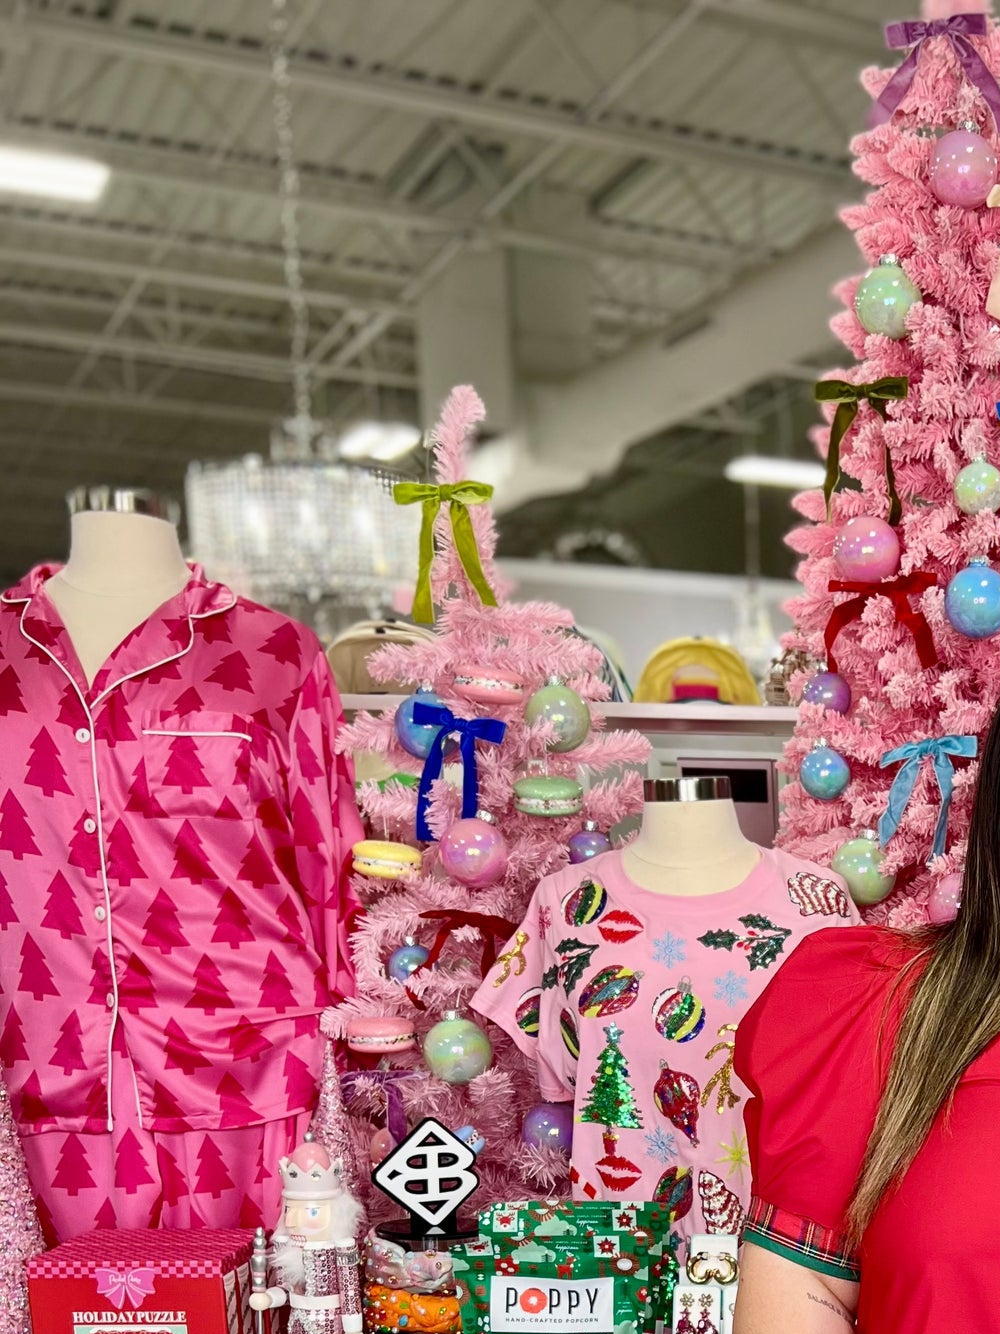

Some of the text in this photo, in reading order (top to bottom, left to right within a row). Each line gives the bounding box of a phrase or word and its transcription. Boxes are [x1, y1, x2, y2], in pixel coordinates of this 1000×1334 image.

[505, 1287, 599, 1314] POPPY
[72, 1311, 187, 1323] HOLIDAY PUZZLE
